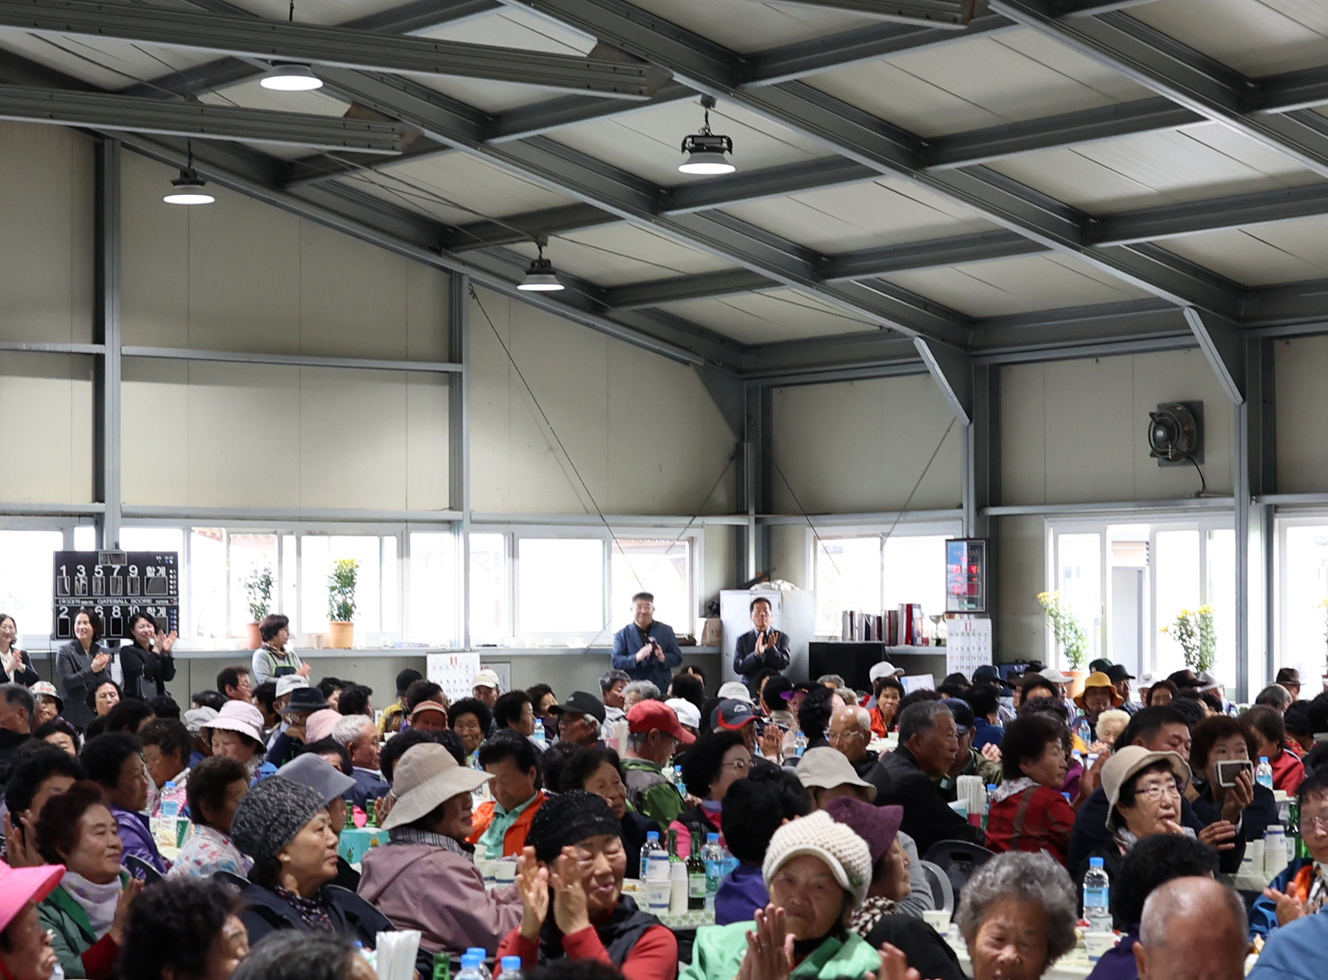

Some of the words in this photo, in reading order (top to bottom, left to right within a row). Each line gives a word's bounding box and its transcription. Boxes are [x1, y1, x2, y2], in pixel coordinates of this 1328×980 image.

[76, 564, 86, 577] 3
[94, 564, 104, 577] 5
[111, 564, 121, 577] 7
[128, 564, 138, 578] 9
[59, 605, 68, 618] 2
[112, 605, 121, 618] 8
